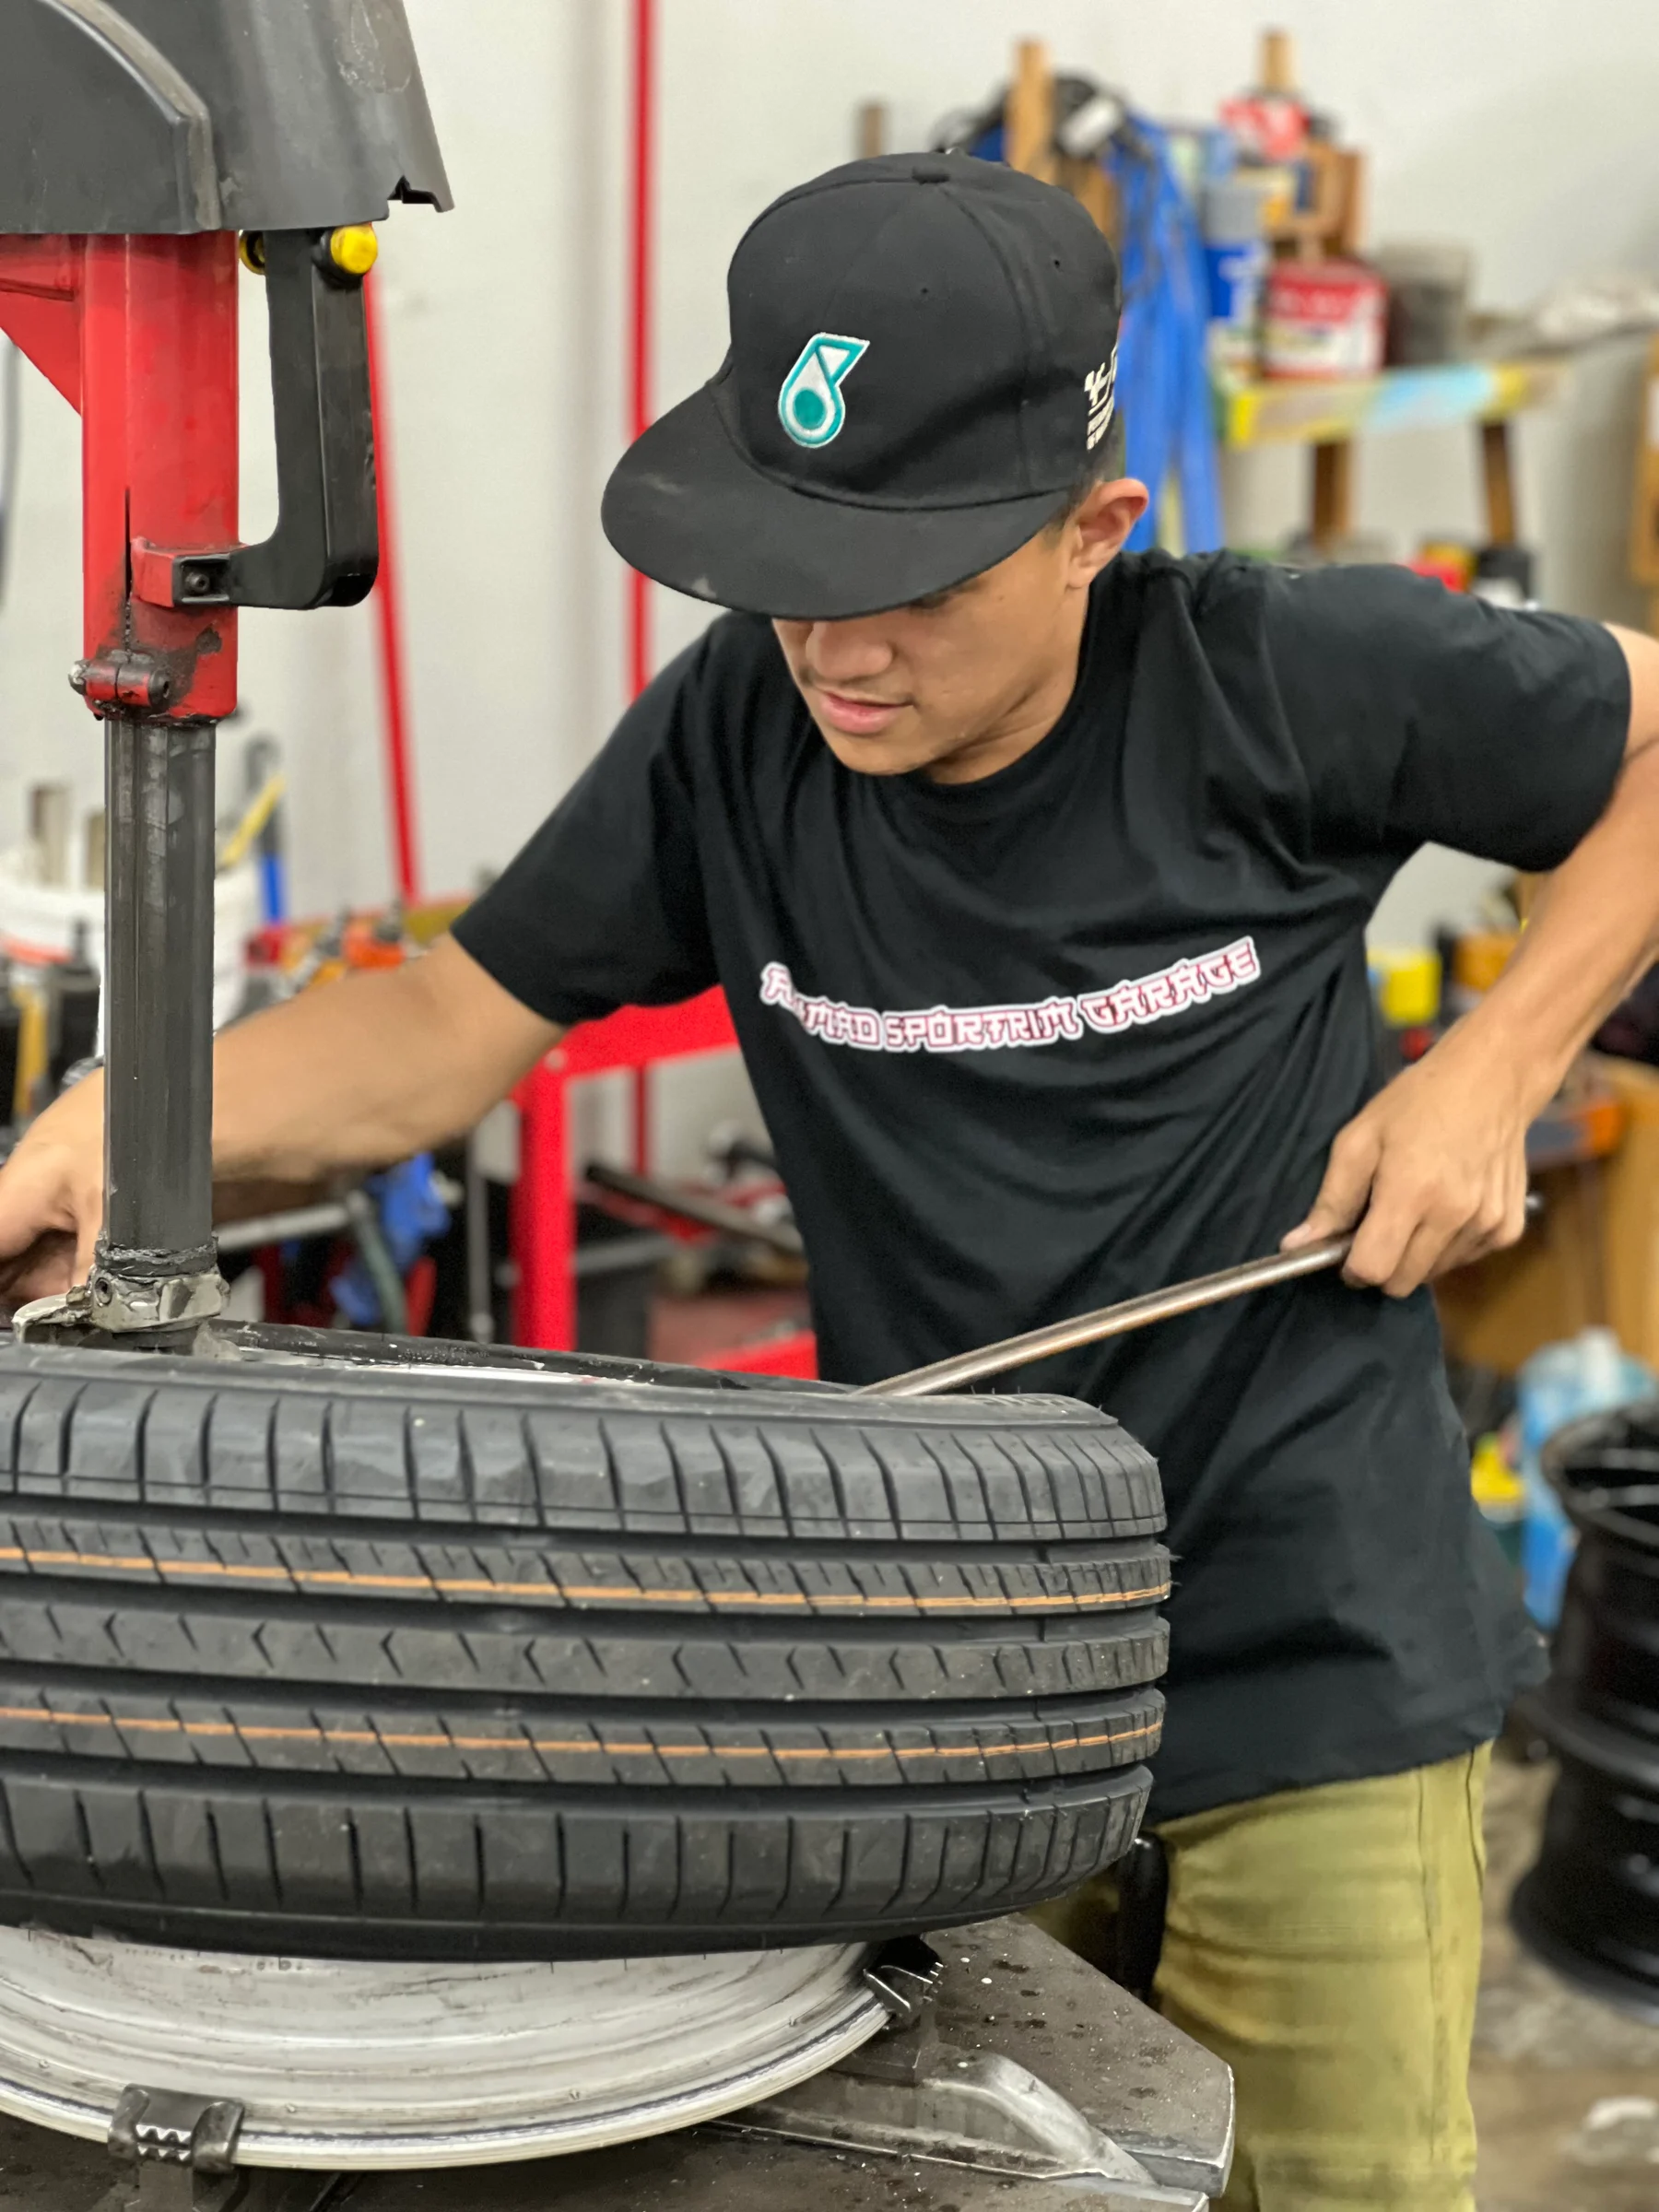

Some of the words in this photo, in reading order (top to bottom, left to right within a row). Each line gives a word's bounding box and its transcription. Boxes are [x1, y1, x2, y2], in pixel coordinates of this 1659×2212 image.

[759, 962, 883, 1050] AMAD
[884, 996, 1083, 1053] SPORTRIM
[1077, 935, 1261, 1033] GARAGE
